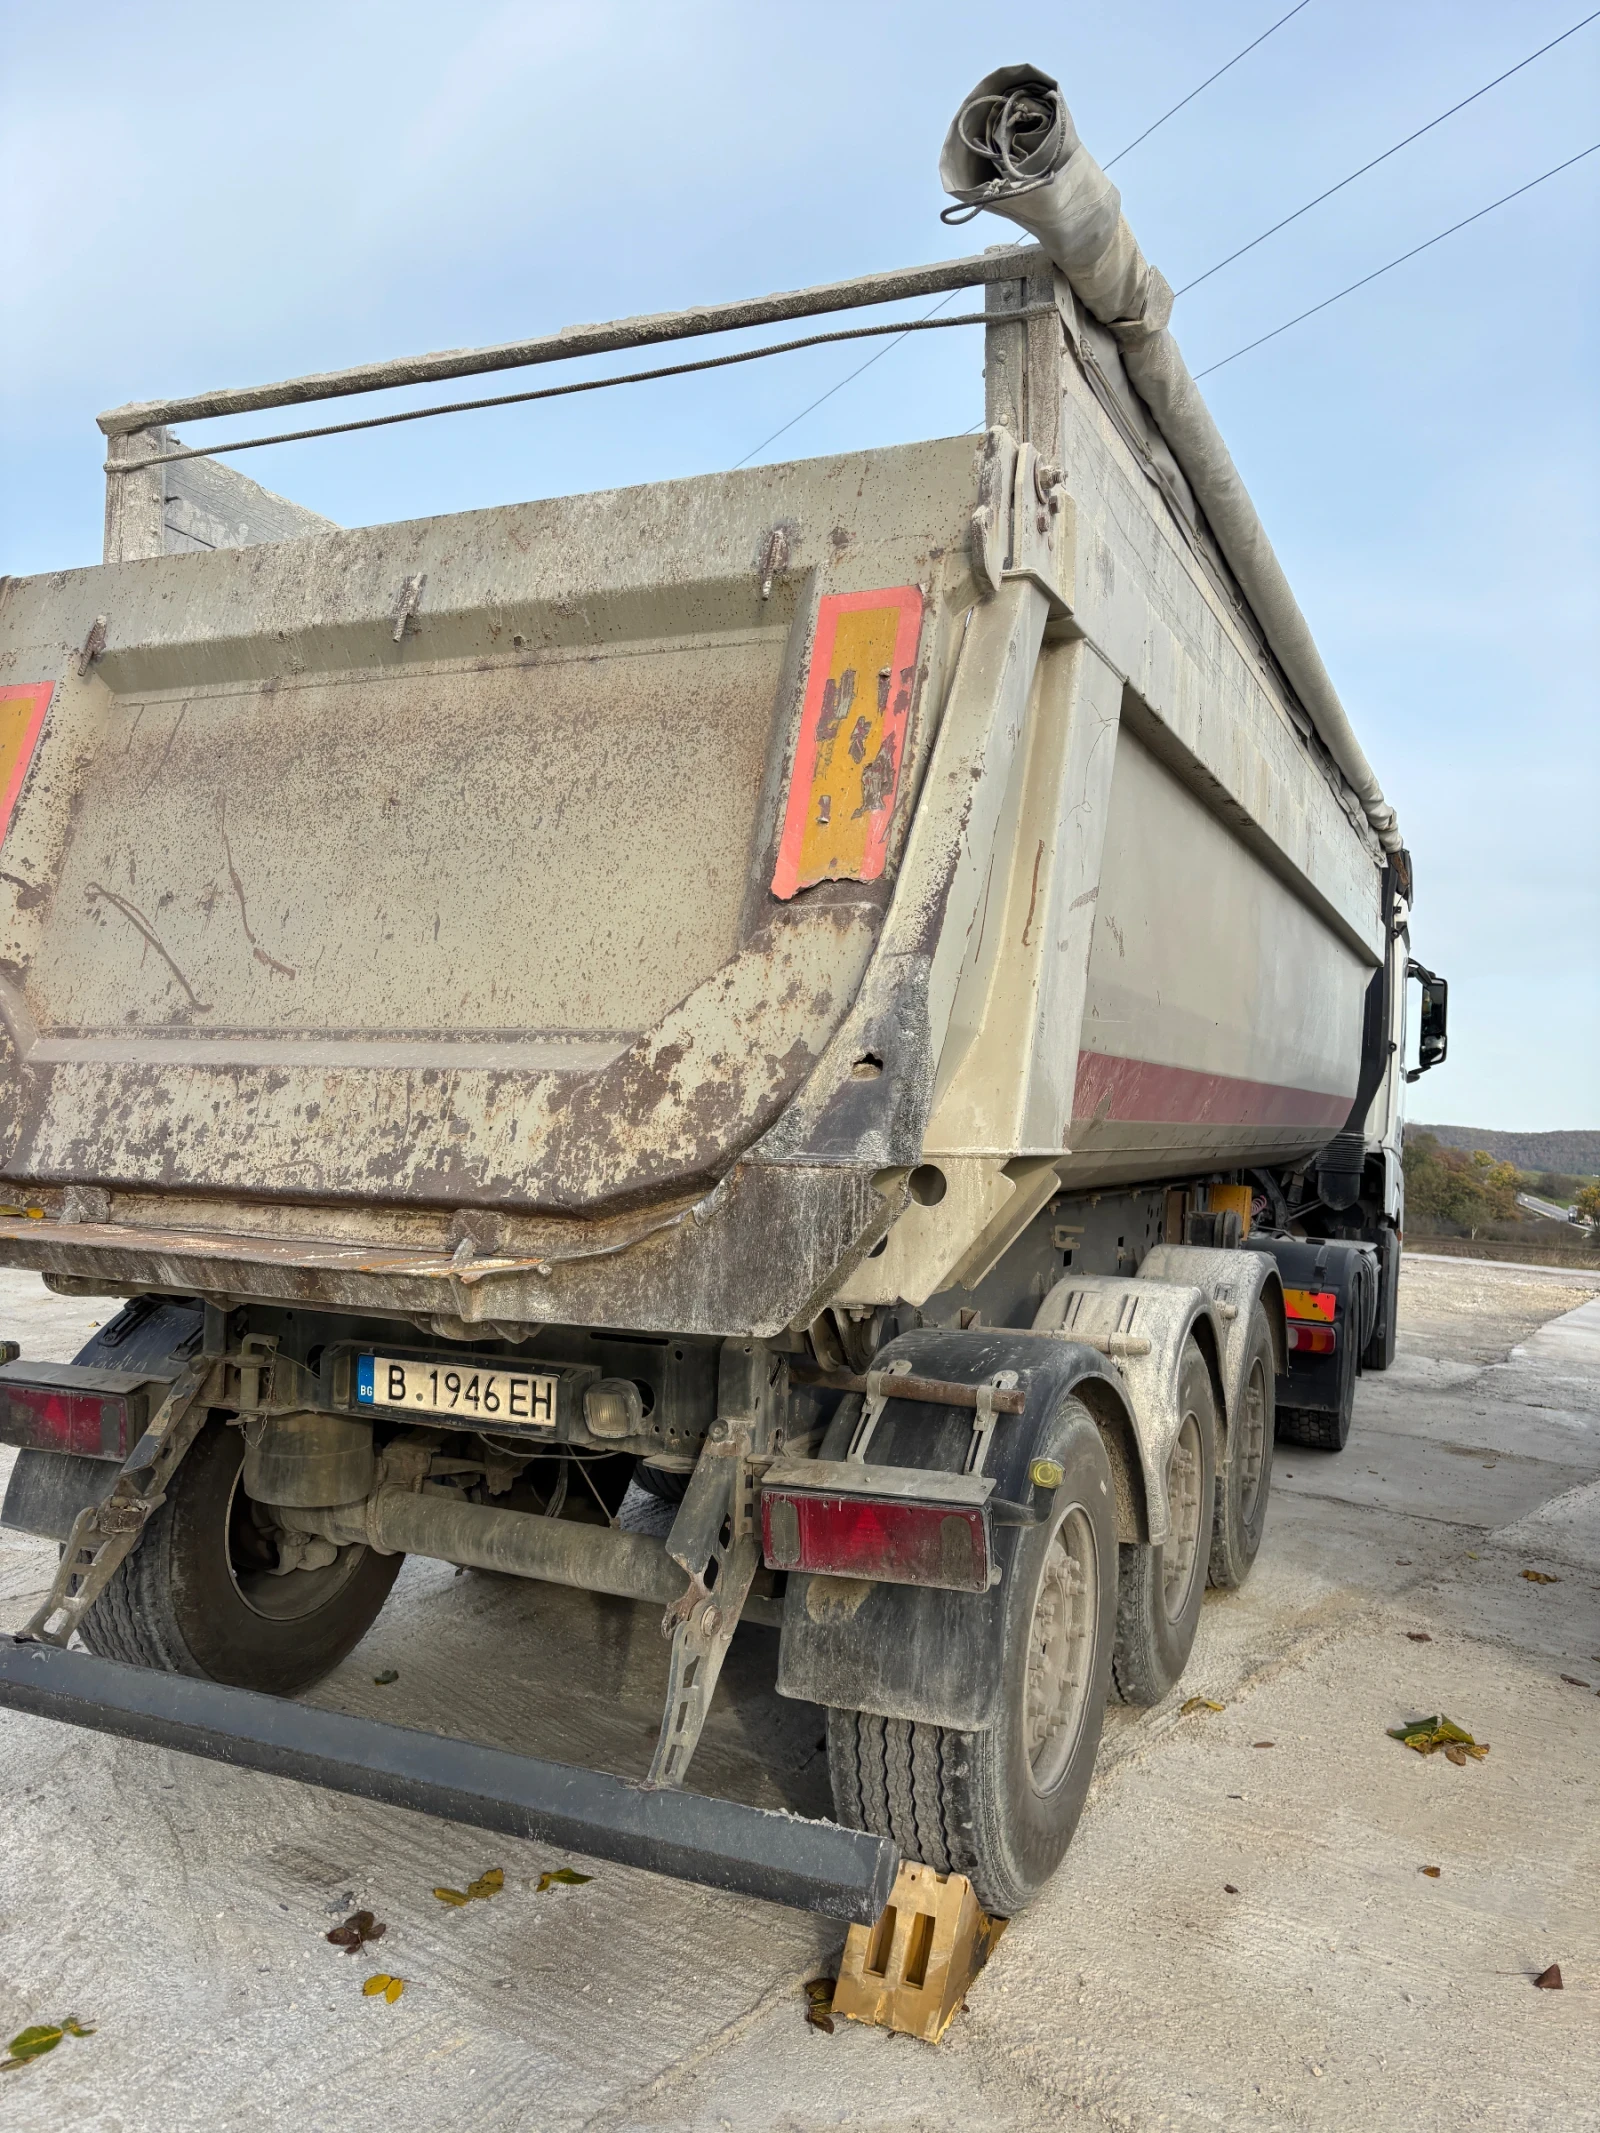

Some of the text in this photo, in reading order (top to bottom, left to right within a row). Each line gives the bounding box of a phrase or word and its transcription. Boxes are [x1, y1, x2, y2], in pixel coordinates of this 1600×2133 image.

[360, 1384, 374, 1397] BG
[429, 1369, 501, 1413] 1946
[509, 1378, 552, 1420] EH
